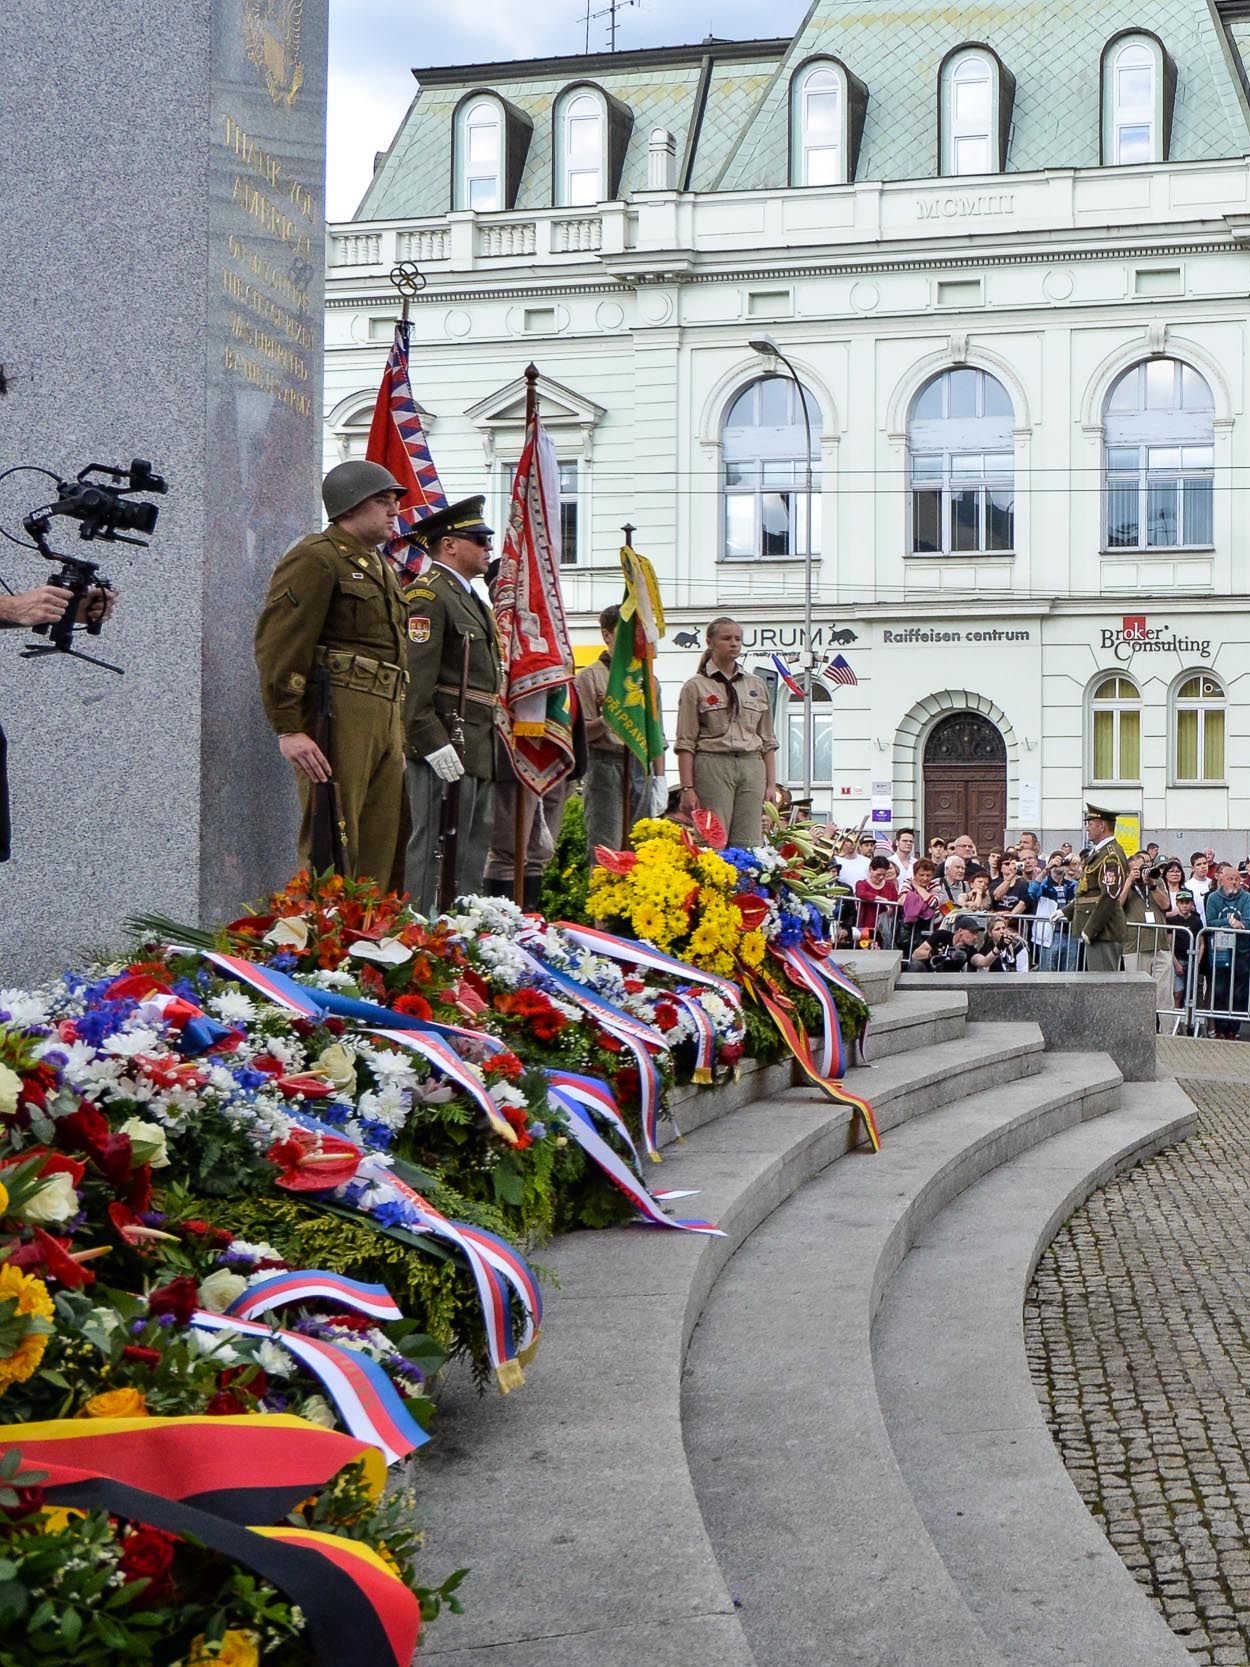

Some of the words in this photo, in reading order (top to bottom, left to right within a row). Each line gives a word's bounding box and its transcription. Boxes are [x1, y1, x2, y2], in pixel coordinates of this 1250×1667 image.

[222, 113, 283, 196] THANK
[916, 195, 1014, 219] MCMIII
[742, 629, 823, 647] URUM
[883, 628, 961, 644] Raiffeisen
[965, 629, 1030, 643] centrum
[1100, 622, 1163, 648] Broker
[1114, 634, 1211, 661] Consulting
